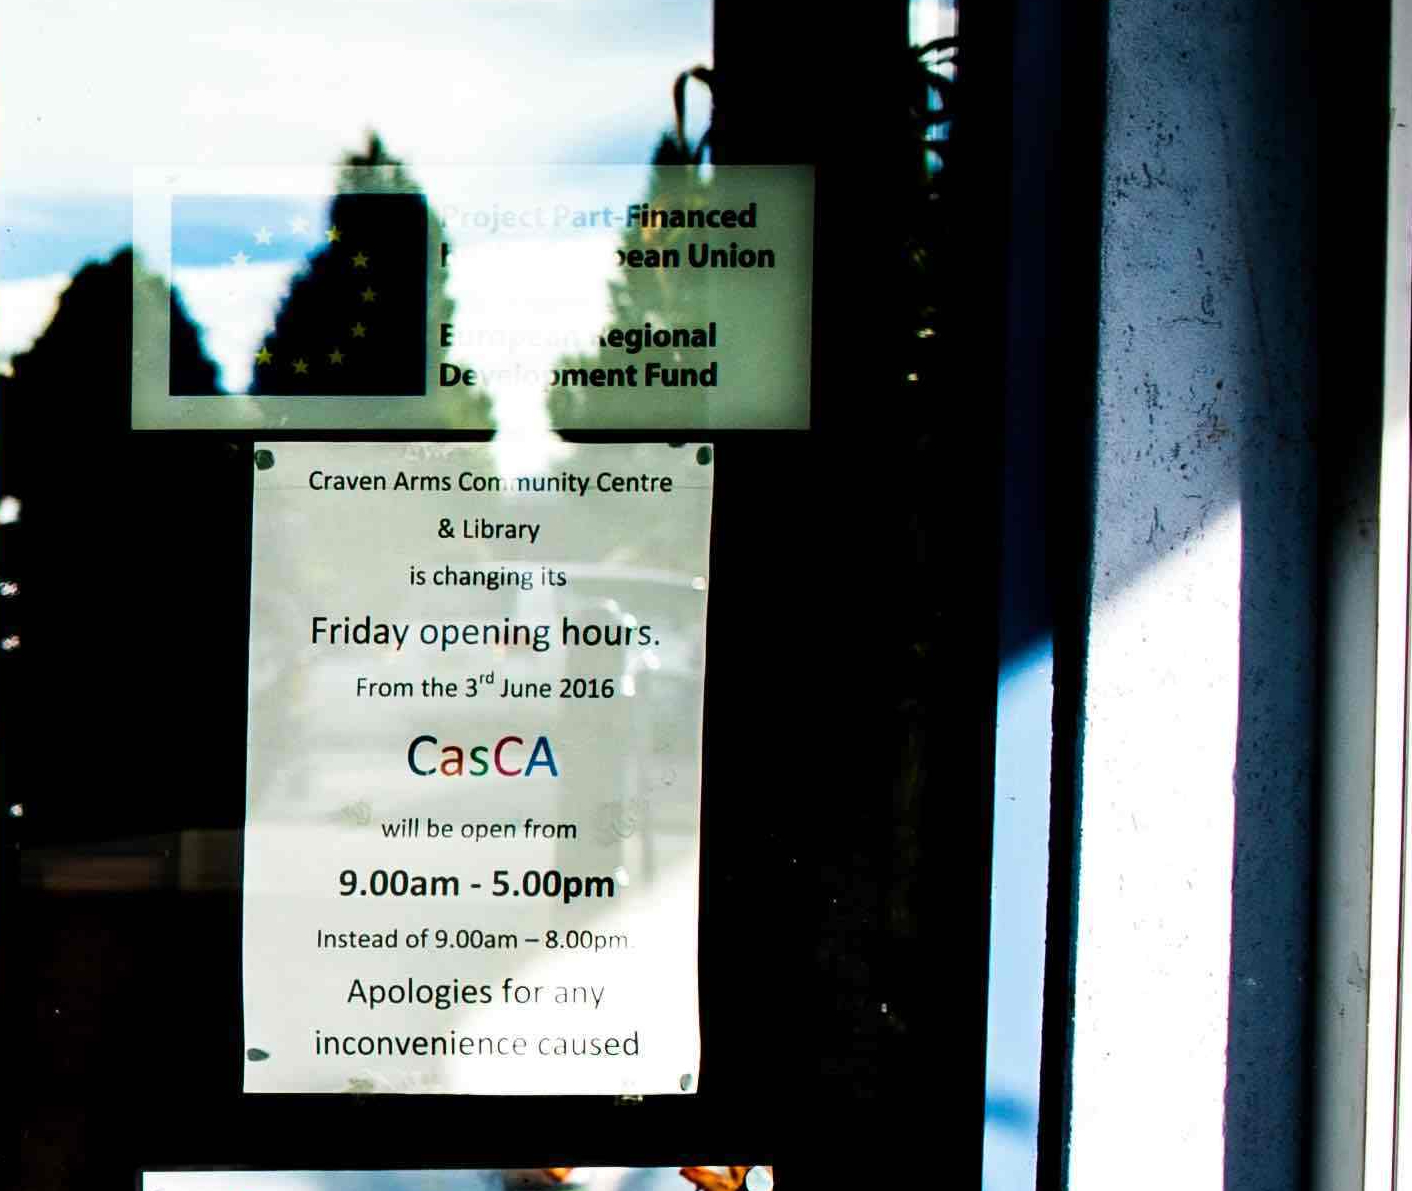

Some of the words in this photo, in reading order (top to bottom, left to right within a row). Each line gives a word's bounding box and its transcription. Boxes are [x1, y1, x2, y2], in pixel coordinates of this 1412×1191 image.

[554, 203, 757, 228] Part-Financed
[688, 242, 774, 268] Union
[646, 363, 717, 387] Fund
[309, 471, 386, 492] Craven
[394, 471, 451, 491] Arms
[596, 472, 673, 492] Centre
[438, 519, 454, 538] &
[464, 519, 540, 543] Library
[410, 566, 426, 586] is
[433, 566, 533, 590] changing
[541, 567, 566, 586] its
[311, 616, 409, 651] Friday
[420, 618, 550, 652] opening
[562, 618, 660, 645] hours.
[357, 679, 414, 697] From
[422, 678, 457, 697] the
[500, 679, 551, 698] June
[559, 679, 613, 699] 2016
[408, 735, 558, 777] CasCA
[382, 819, 419, 838] will
[427, 819, 453, 838] be
[461, 822, 516, 841] open
[524, 819, 576, 839] from
[340, 870, 459, 897] 9.00am
[492, 870, 614, 904] 5.00pm
[317, 930, 397, 948] Instead
[405, 929, 428, 948] of
[435, 931, 518, 948] 9.00am
[348, 979, 492, 1009] Apologies
[503, 979, 544, 1004] for
[555, 984, 604, 1009] any
[316, 1031, 527, 1057] inconvenience
[539, 1031, 639, 1057] caused
